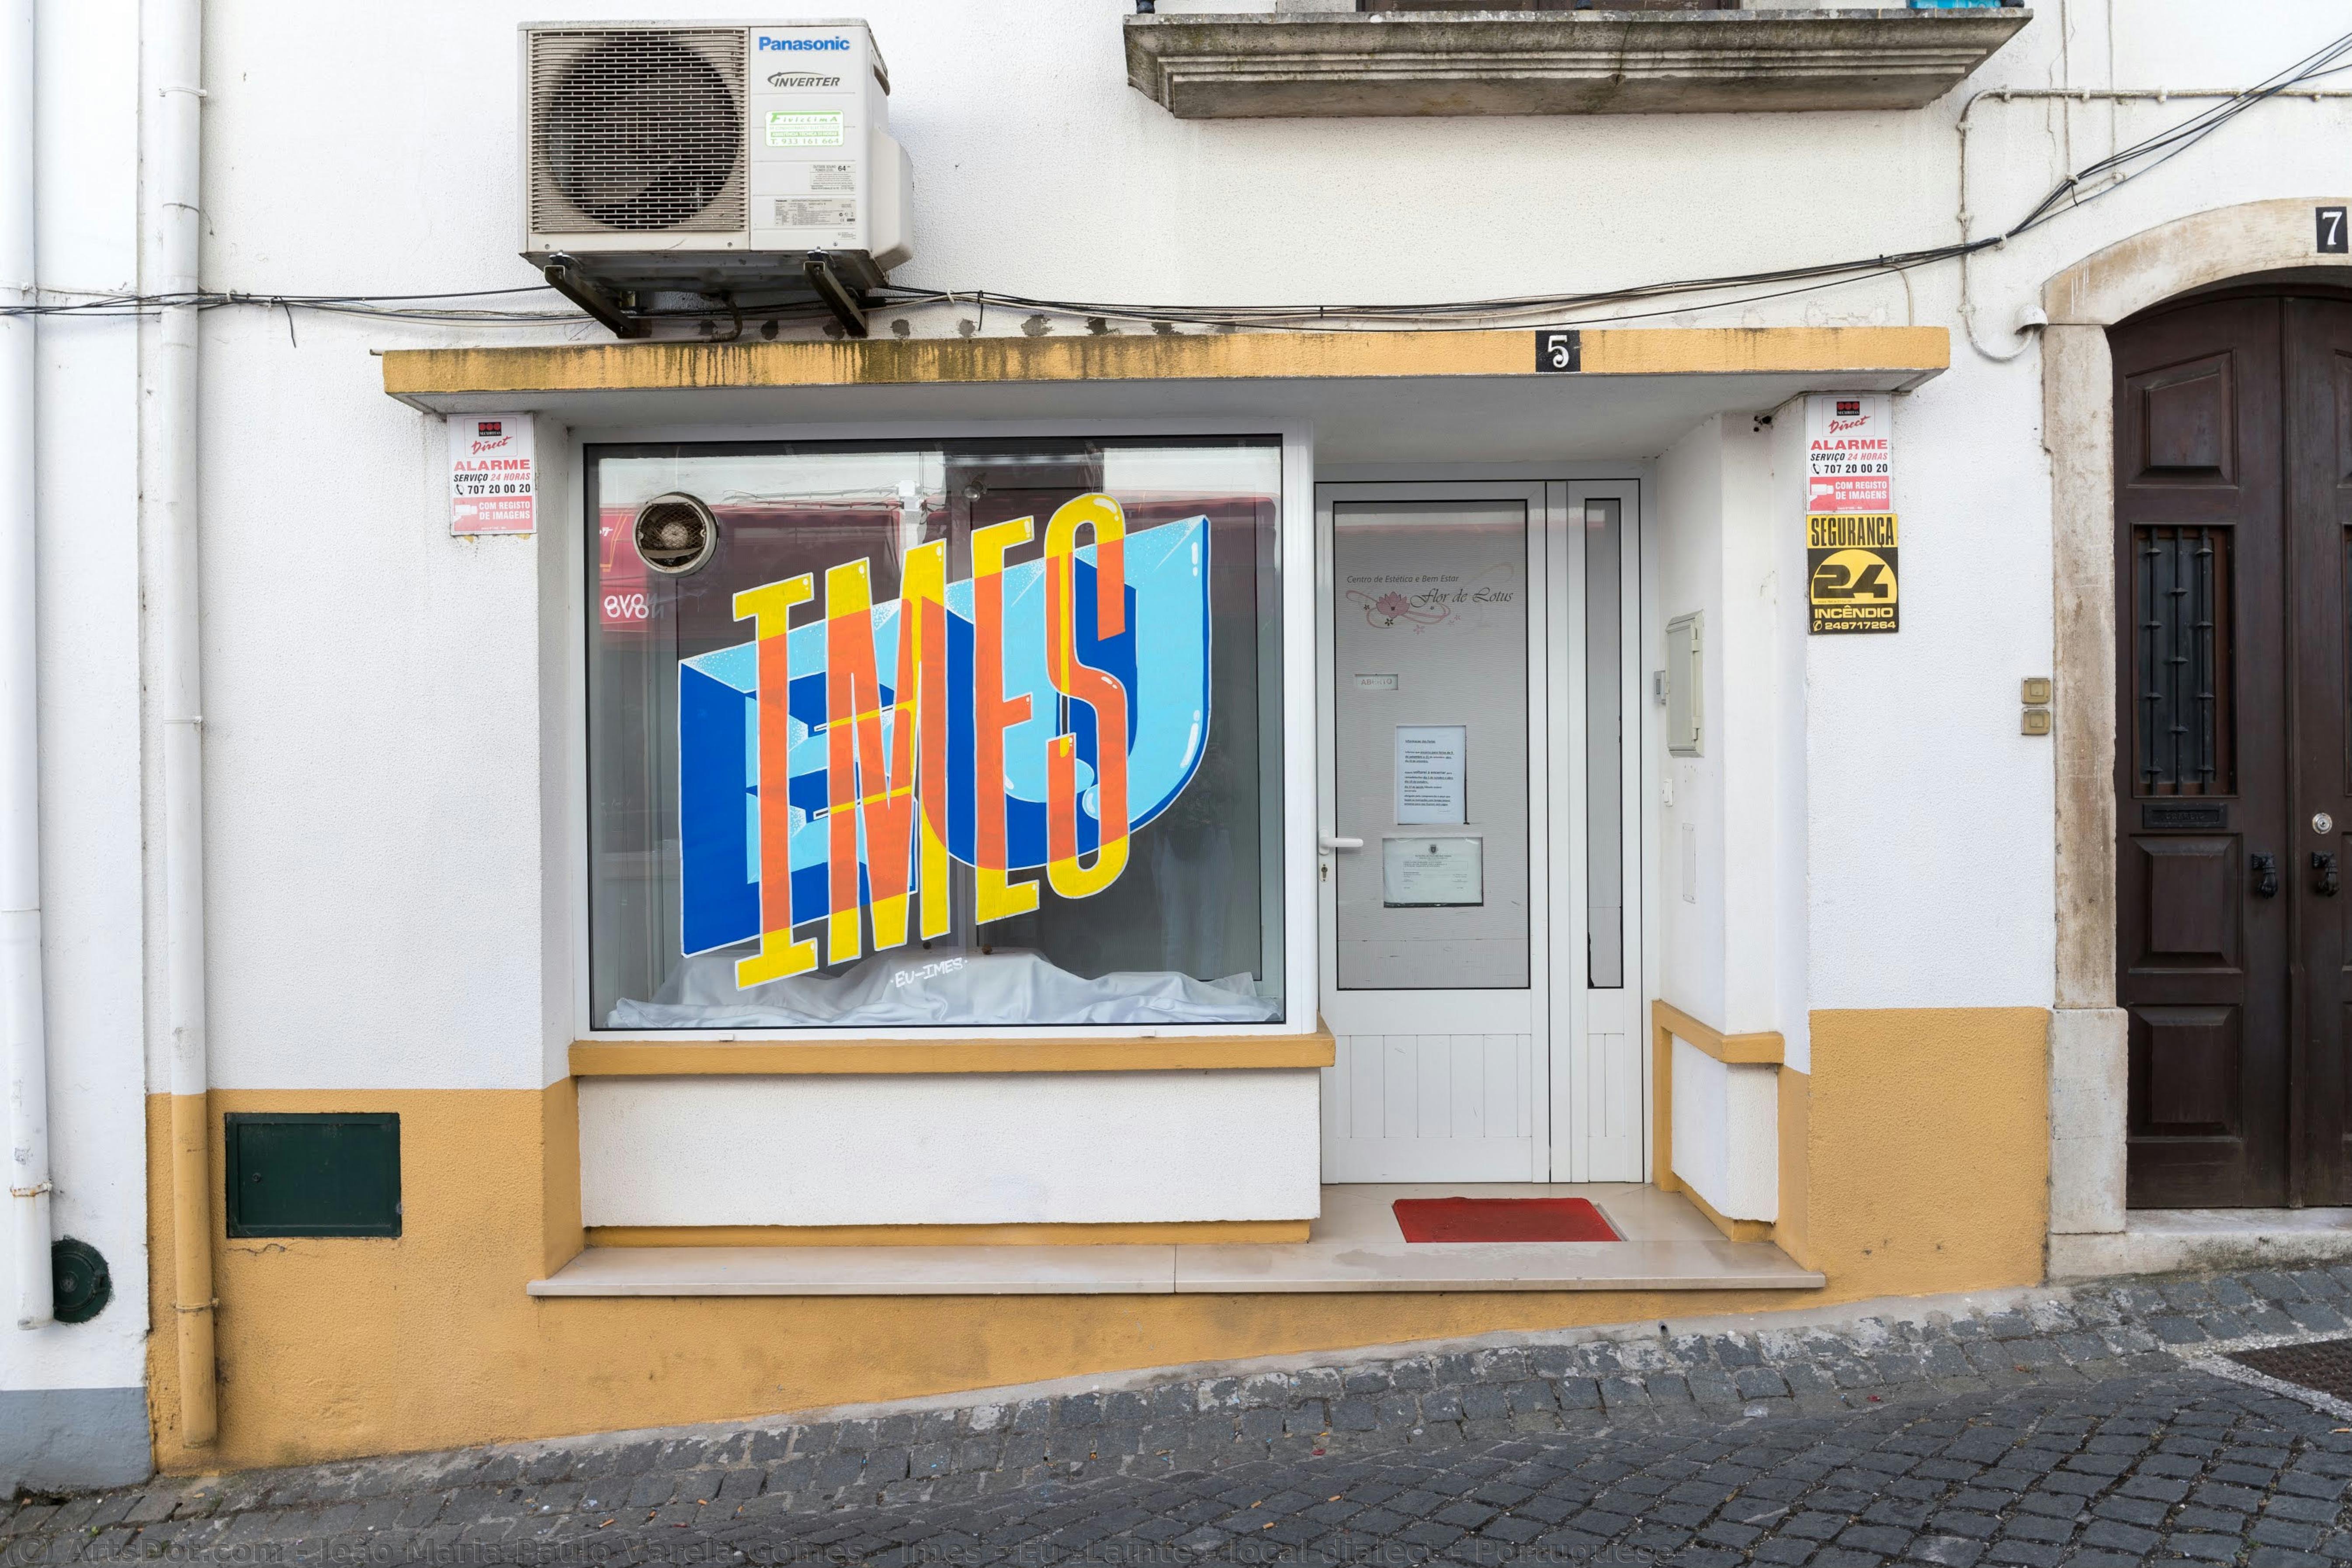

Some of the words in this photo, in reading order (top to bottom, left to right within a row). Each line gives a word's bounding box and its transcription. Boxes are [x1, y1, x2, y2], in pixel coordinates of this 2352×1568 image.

[759, 36, 850, 51] Panasonic
[773, 76, 840, 87] INVERTER
[2323, 211, 2342, 245] 7
[1547, 335, 1569, 368] 5
[1828, 415, 1871, 434] Direct
[471, 436, 513, 454] Direct
[1811, 440, 1887, 450] ALARME
[1811, 453, 1845, 462] SERVIÇO
[454, 460, 530, 471] ALARME
[1825, 465, 1841, 473] 707
[1846, 464, 1857, 473] 20
[1861, 464, 1872, 472] 00
[1876, 464, 1887, 472] 20
[454, 474, 488, 483] SERVIÇO
[468, 485, 484, 494] 707
[489, 485, 500, 493] 20
[520, 484, 530, 492] 20
[1849, 491, 1887, 499] IMAGENS
[499, 501, 530, 509] REGISTO
[493, 511, 530, 519] IMAGENS
[1811, 517, 1894, 547] SEGURANÇA
[1814, 564, 1888, 599] 24
[1410, 588, 1450, 608] Flor
[1452, 588, 1467, 602] de
[1472, 587, 1513, 602] Lotus
[1814, 605, 1894, 618] INCÊNDIO
[1825, 621, 1896, 630] 249717264
